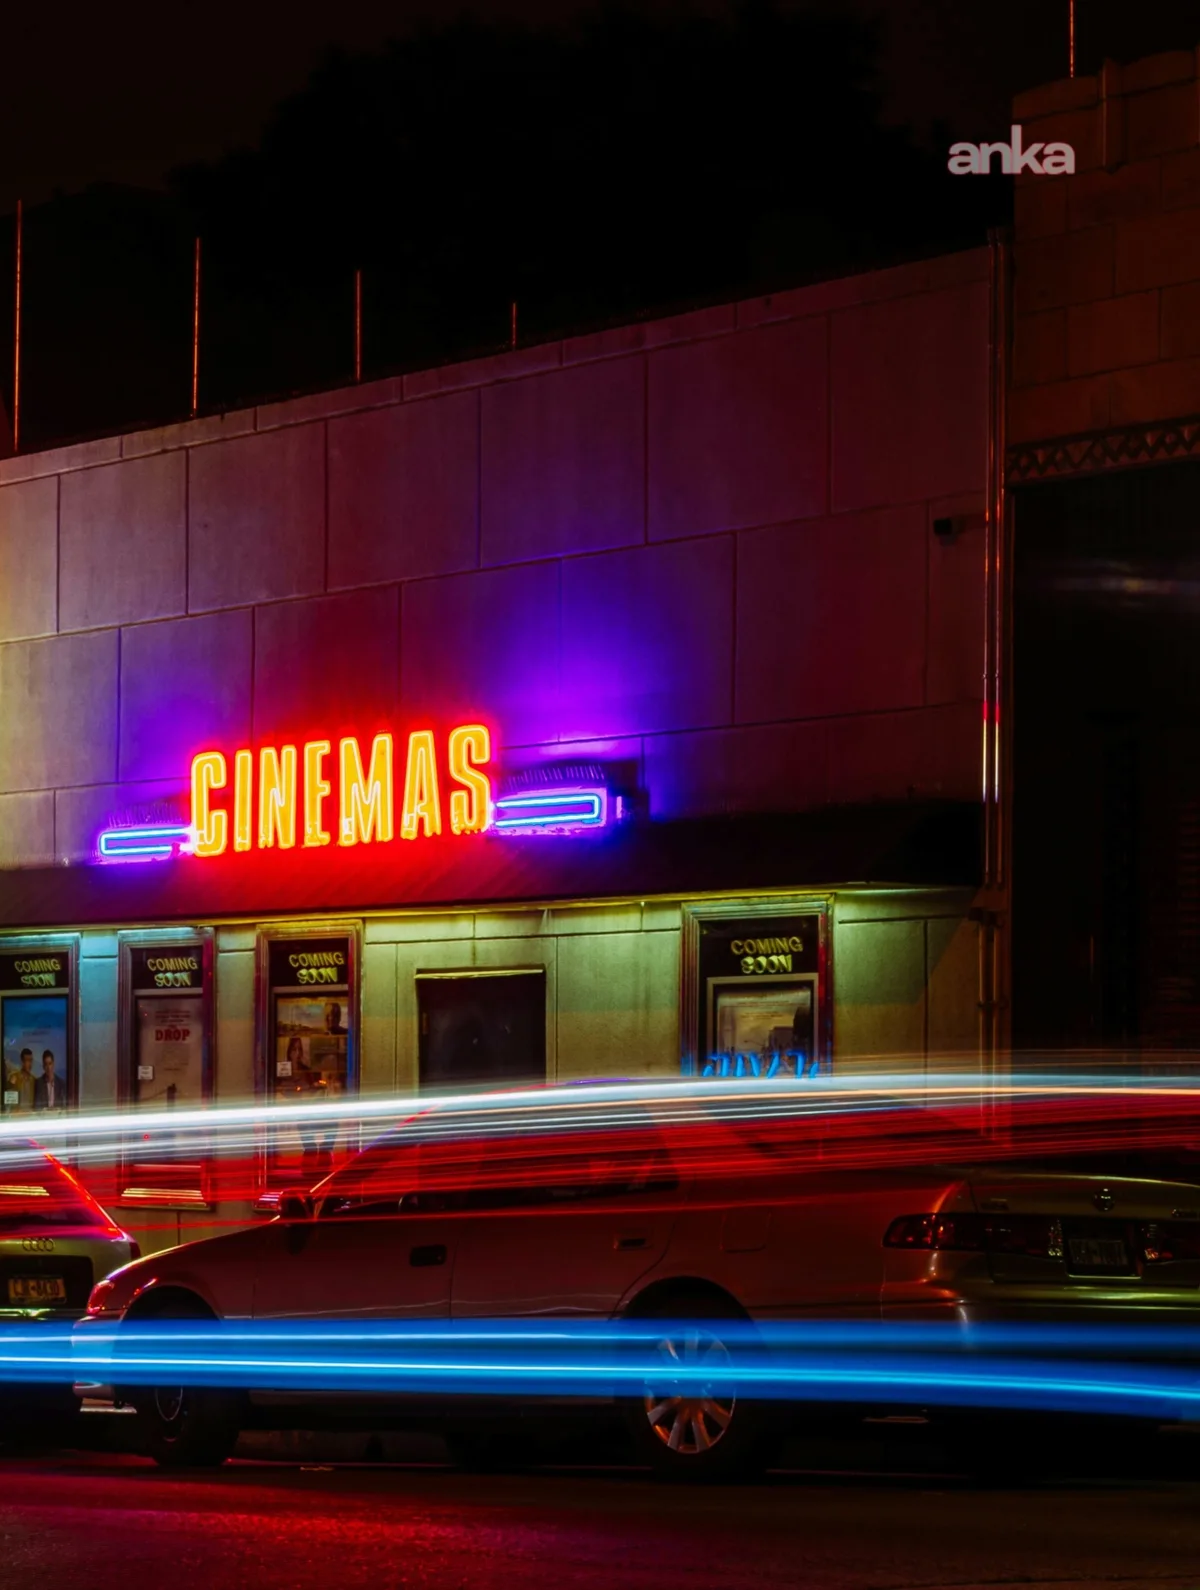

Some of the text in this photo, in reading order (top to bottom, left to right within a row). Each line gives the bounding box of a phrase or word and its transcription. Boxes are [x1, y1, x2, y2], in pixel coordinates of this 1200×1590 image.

[190, 724, 492, 858] CINEMAS
[730, 936, 804, 955] COMING
[13, 958, 62, 973] COMING
[146, 956, 199, 972] COMING
[287, 951, 345, 968] COMING
[740, 953, 793, 974] SOON
[20, 972, 57, 988] SOON
[153, 971, 193, 988] SOON
[295, 966, 339, 985] SOON
[154, 1028, 191, 1042] DROP
